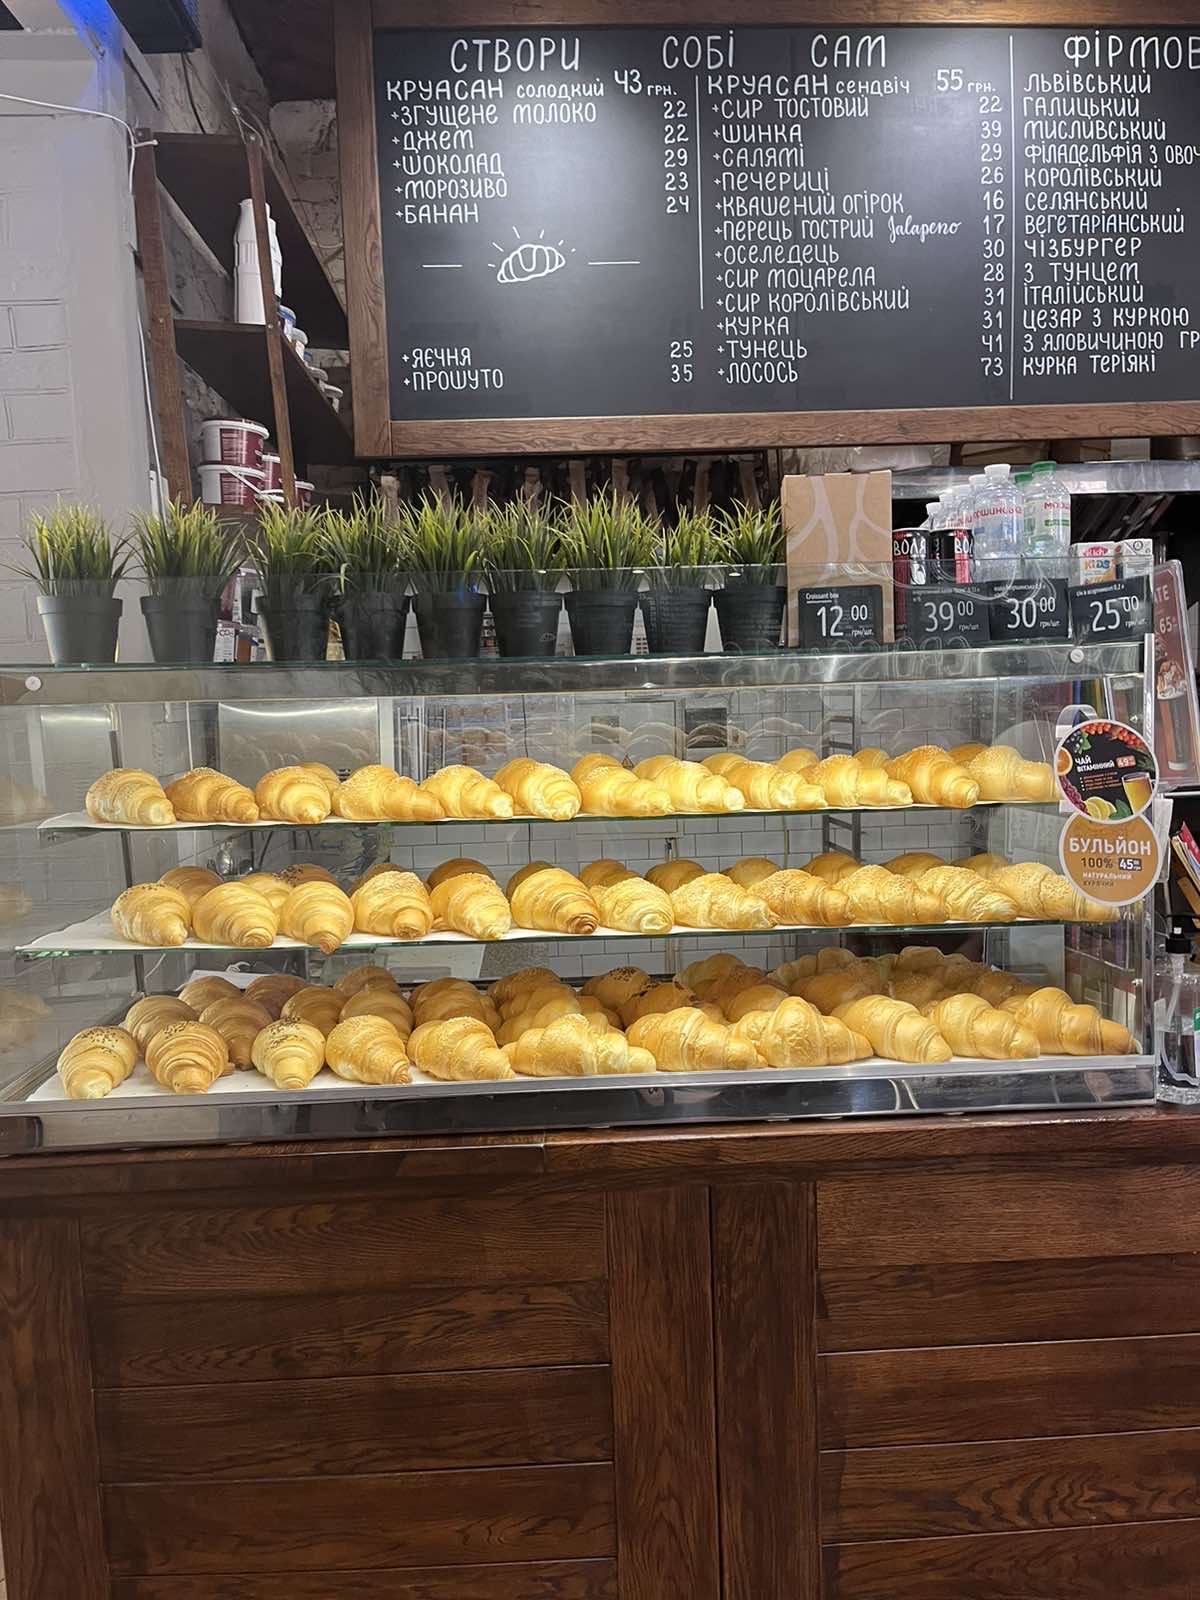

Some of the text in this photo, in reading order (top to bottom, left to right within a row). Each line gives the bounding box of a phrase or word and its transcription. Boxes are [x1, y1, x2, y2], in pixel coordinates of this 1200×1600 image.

[450, 30, 887, 73] СТВОРИ СОБІ САМ
[386, 79, 504, 101] КРУАСАН
[516, 77, 605, 101] солодкий
[614, 68, 643, 95] 43
[707, 74, 829, 96] КРУАСАН
[836, 75, 910, 97] сендвіч
[936, 69, 963, 92] 55
[1024, 69, 1151, 94] ЛЬВІВСЬКИЙ
[513, 102, 597, 125] МОЛОКО
[663, 100, 688, 120] 22
[774, 94, 869, 119] ТОСТОВИЙ
[979, 96, 1003, 114] 22
[1023, 94, 1140, 120] ГАЛИЦЬКИЙ
[664, 125, 689, 145] 22
[981, 119, 1002, 139] 39
[1024, 118, 1166, 141] МИСЛИВСЬКИЙ
[664, 148, 689, 169] 29
[981, 143, 1003, 163] 29
[1024, 140, 1142, 166] ФІЛАДЕЛЬФІЯ
[665, 172, 690, 191] 23
[981, 166, 1005, 185] 26
[1024, 164, 1162, 188] КОРОЛІВСЬКИЙ
[666, 196, 690, 214] 24
[842, 190, 905, 215] ОГІРОК
[983, 190, 1005, 211] 16
[1025, 187, 1148, 211] СЕЛЯНСЬКИЙ
[801, 215, 874, 240] ГОСТРИЙ
[888, 215, 962, 243] Jalapeno
[983, 214, 1005, 235] 17
[1025, 208, 1185, 234] ВЕГЕТАРІАНСЬКИЙ
[983, 239, 1005, 259] 30
[1024, 234, 1142, 258] ЧІЗБУРГЕР
[768, 266, 876, 292] МОЦАРЕЛА
[983, 263, 1005, 282] 28
[1049, 261, 1139, 285] ТУНЦЕМ
[768, 285, 909, 313] КОРОЛІВСЬКИЙ
[984, 287, 1005, 306] 31
[1023, 280, 1144, 305] ІТАЛІЙСЬКИЙ
[982, 310, 1003, 330] 31
[1023, 308, 1082, 332] ЦЕЗАР
[1113, 307, 1190, 328] КУРКОЮ
[670, 340, 694, 359] 25
[981, 334, 1003, 353] 41
[1041, 331, 1164, 352] ЯЛОВИЧИНОЮ
[671, 363, 694, 383] 35
[980, 357, 1004, 377] 73
[1023, 350, 1157, 376] КУРКА ТЕРІЯКІ
[816, 604, 868, 637] 12 00
[924, 600, 974, 632] 39 00
[1006, 596, 1056, 628] 30 00
[1090, 595, 1139, 632] 25 00
[1075, 755, 1091, 765] ЧАЙ
[1069, 835, 1152, 856] БУЛЬЙОН
[1081, 857, 1113, 869] 100%
[1119, 858, 1133, 870] 45
